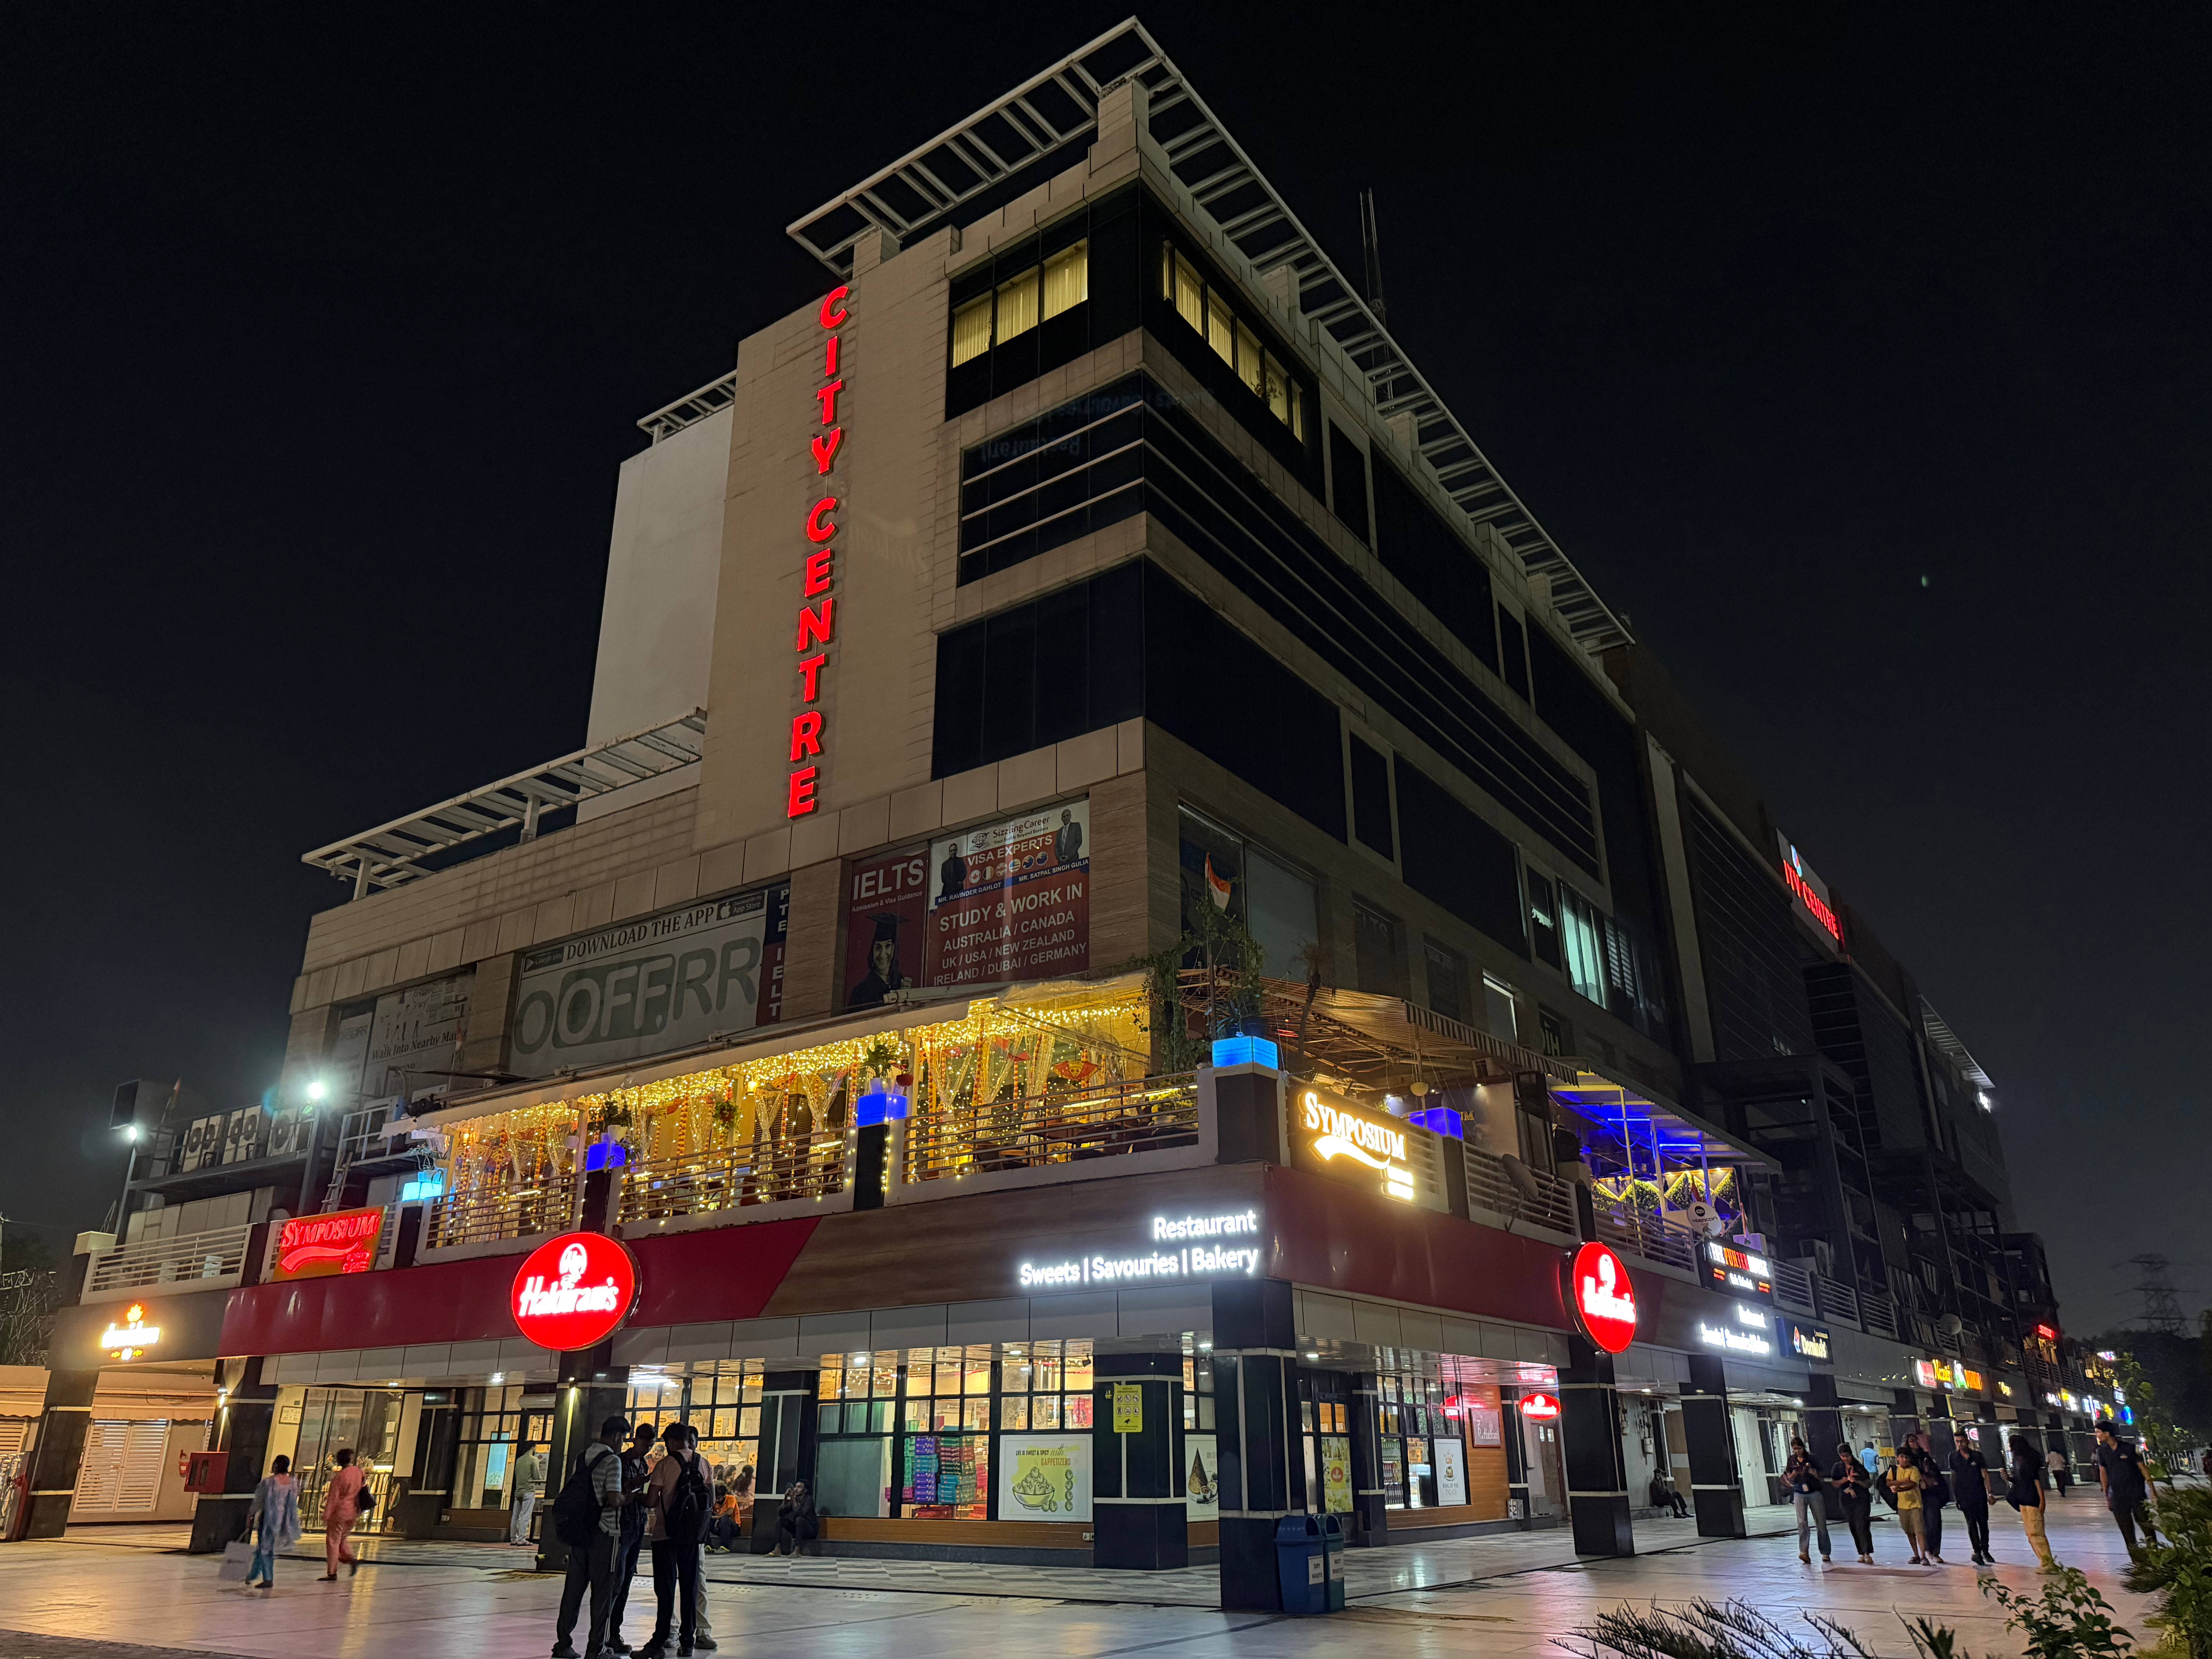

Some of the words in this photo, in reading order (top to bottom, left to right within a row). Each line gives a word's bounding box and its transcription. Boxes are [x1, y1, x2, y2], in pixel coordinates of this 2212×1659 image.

[812, 285, 850, 474] CITY
[788, 497, 837, 819] CENTRE
[993, 825, 1023, 838] Sizzling
[1025, 816, 1050, 829] Career
[967, 850, 994, 866] VISA
[997, 835, 1053, 859] EXPERTS
[1030, 869, 1051, 879] SATPAL
[1052, 864, 1070, 874] SINGH
[1071, 859, 1089, 869] GULIA
[853, 859, 924, 901] IELTS
[938, 895, 948, 903] MR.
[949, 889, 977, 901] RAVINDER
[978, 882, 1002, 893] GAHLOT
[1783, 859, 1801, 898] ITY
[733, 905, 745, 914] App
[745, 902, 761, 911] Store
[777, 889, 790, 933] PTE
[852, 902, 878, 912] Admission
[885, 897, 896, 905] Visa
[897, 891, 922, 902] Guidance
[939, 905, 992, 932] STUDY
[995, 902, 1006, 918] &
[1010, 887, 1062, 915] WORK
[1066, 882, 1082, 901] IN
[567, 924, 647, 960] DOWNLOAD
[652, 915, 681, 937] THE
[684, 907, 714, 929] APP
[942, 956, 957, 969] UK
[965, 950, 987, 964] USA
[995, 942, 1020, 957] NEW
[1022, 929, 1075, 951] ZEALAND
[943, 926, 1011, 952] AUSTRALIA
[1021, 910, 1075, 933] CANADA
[934, 967, 979, 986] IRELAND
[988, 957, 1021, 974] DUBAI
[1030, 942, 1087, 965] GERMANY
[373, 1044, 390, 1060] Walk
[393, 1043, 409, 1056] Into
[411, 1035, 440, 1051] Nearby
[1305, 1092, 1406, 1161] SYMPOSIUM
[282, 1214, 380, 1248] SYMPOSIUM
[1153, 1209, 1257, 1239] Restaurant
[1020, 1261, 1080, 1285] Sweets
[1092, 1252, 1179, 1279] Savouries
[1191, 1245, 1259, 1274] Bakery
